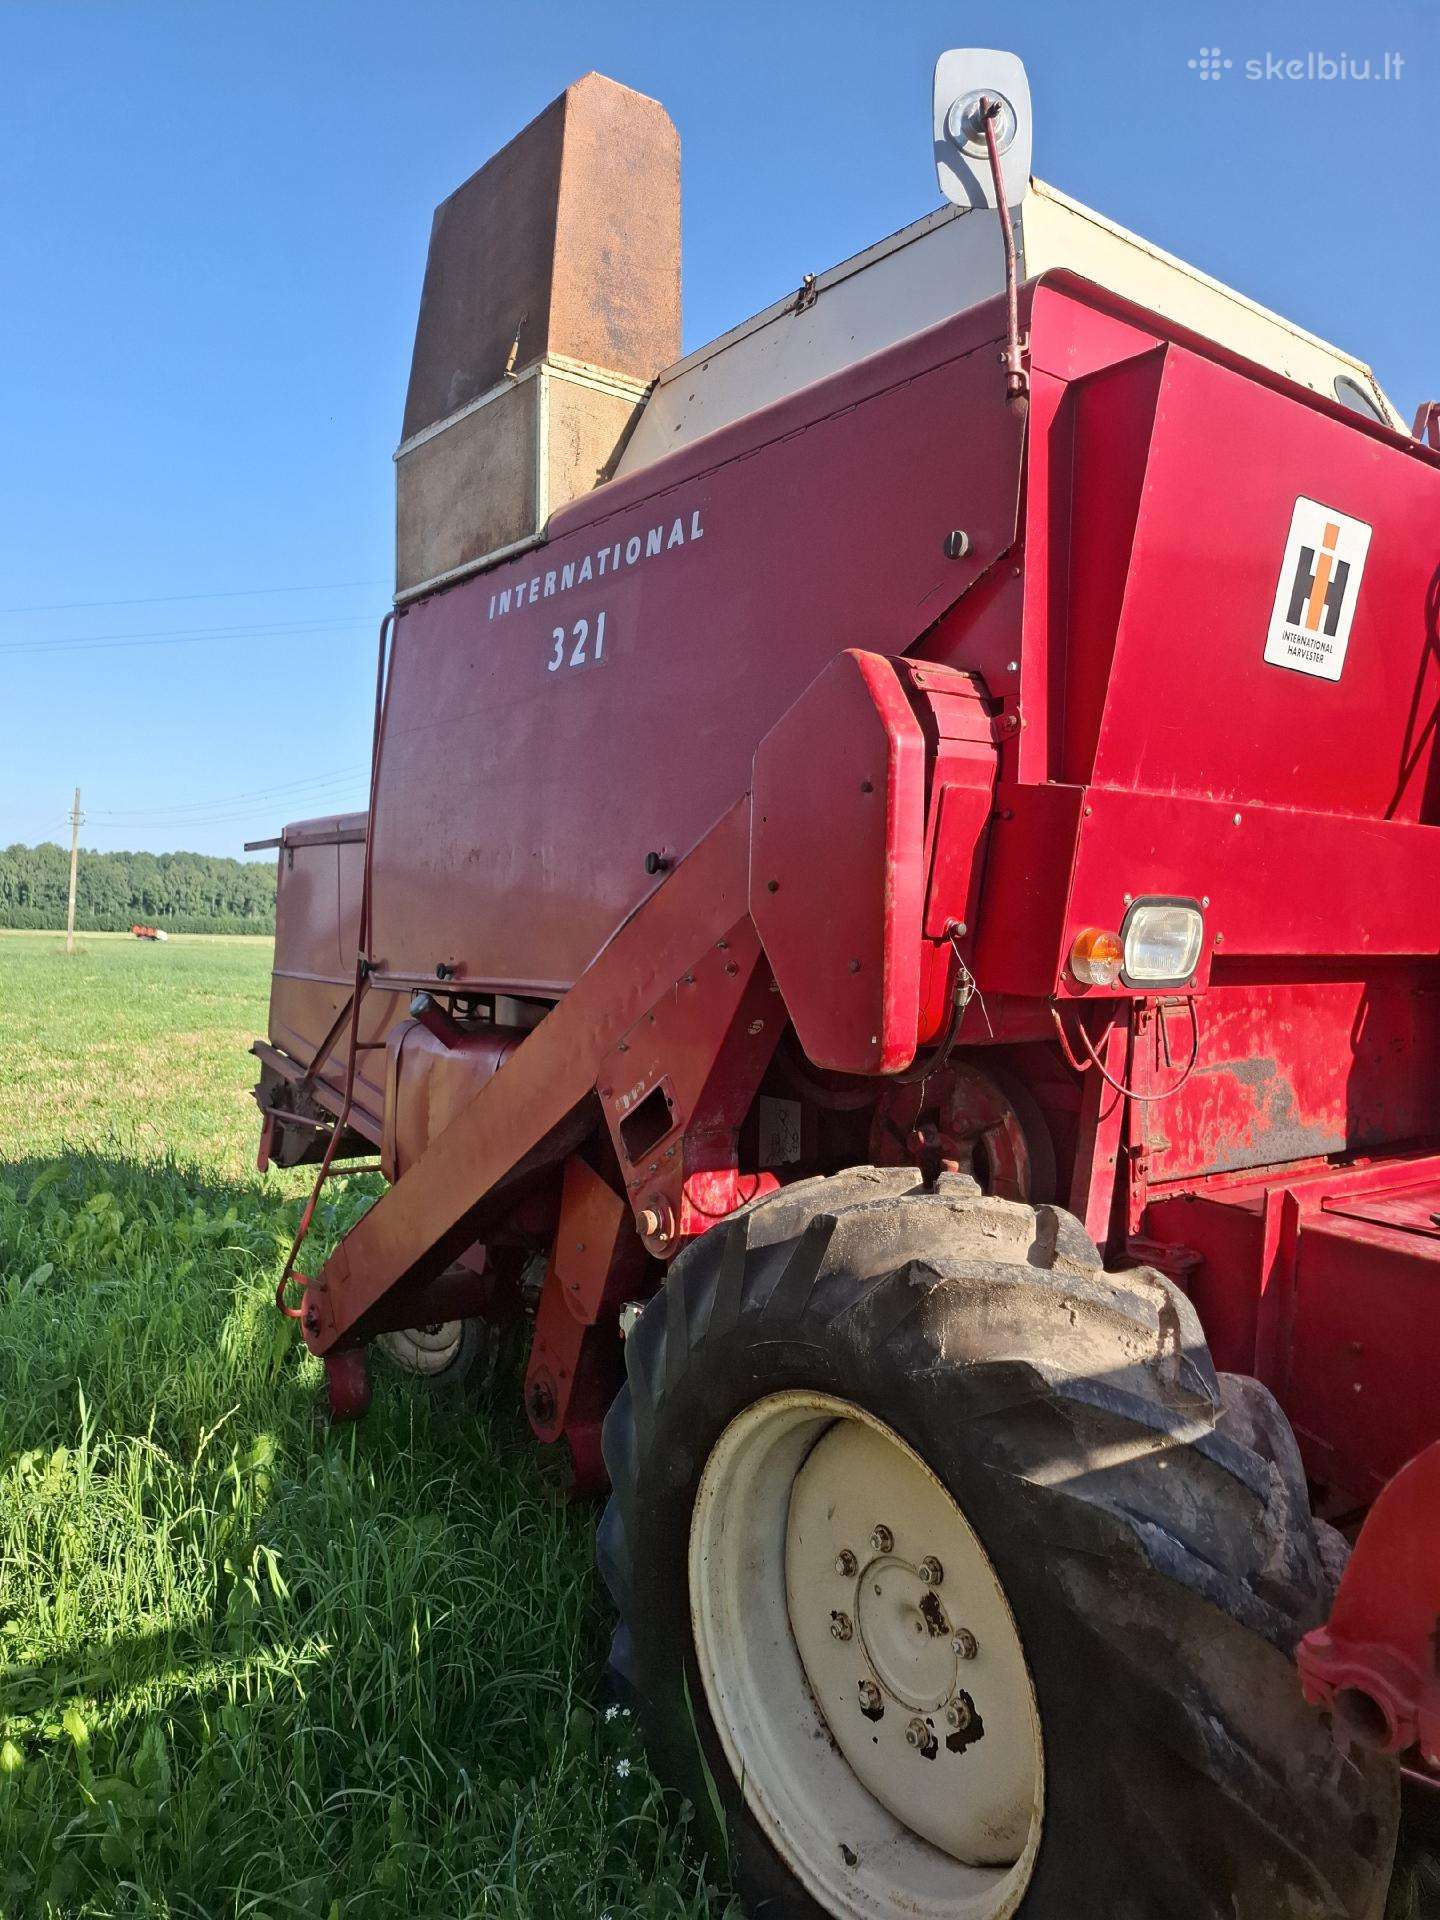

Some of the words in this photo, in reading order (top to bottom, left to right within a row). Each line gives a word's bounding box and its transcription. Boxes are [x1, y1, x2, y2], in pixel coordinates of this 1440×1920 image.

[489, 510, 704, 620] INTERNATIONAL
[548, 611, 606, 672] 321
[1282, 630, 1333, 654] INTERNATIONAL
[1287, 645, 1324, 664] HARVESTER
